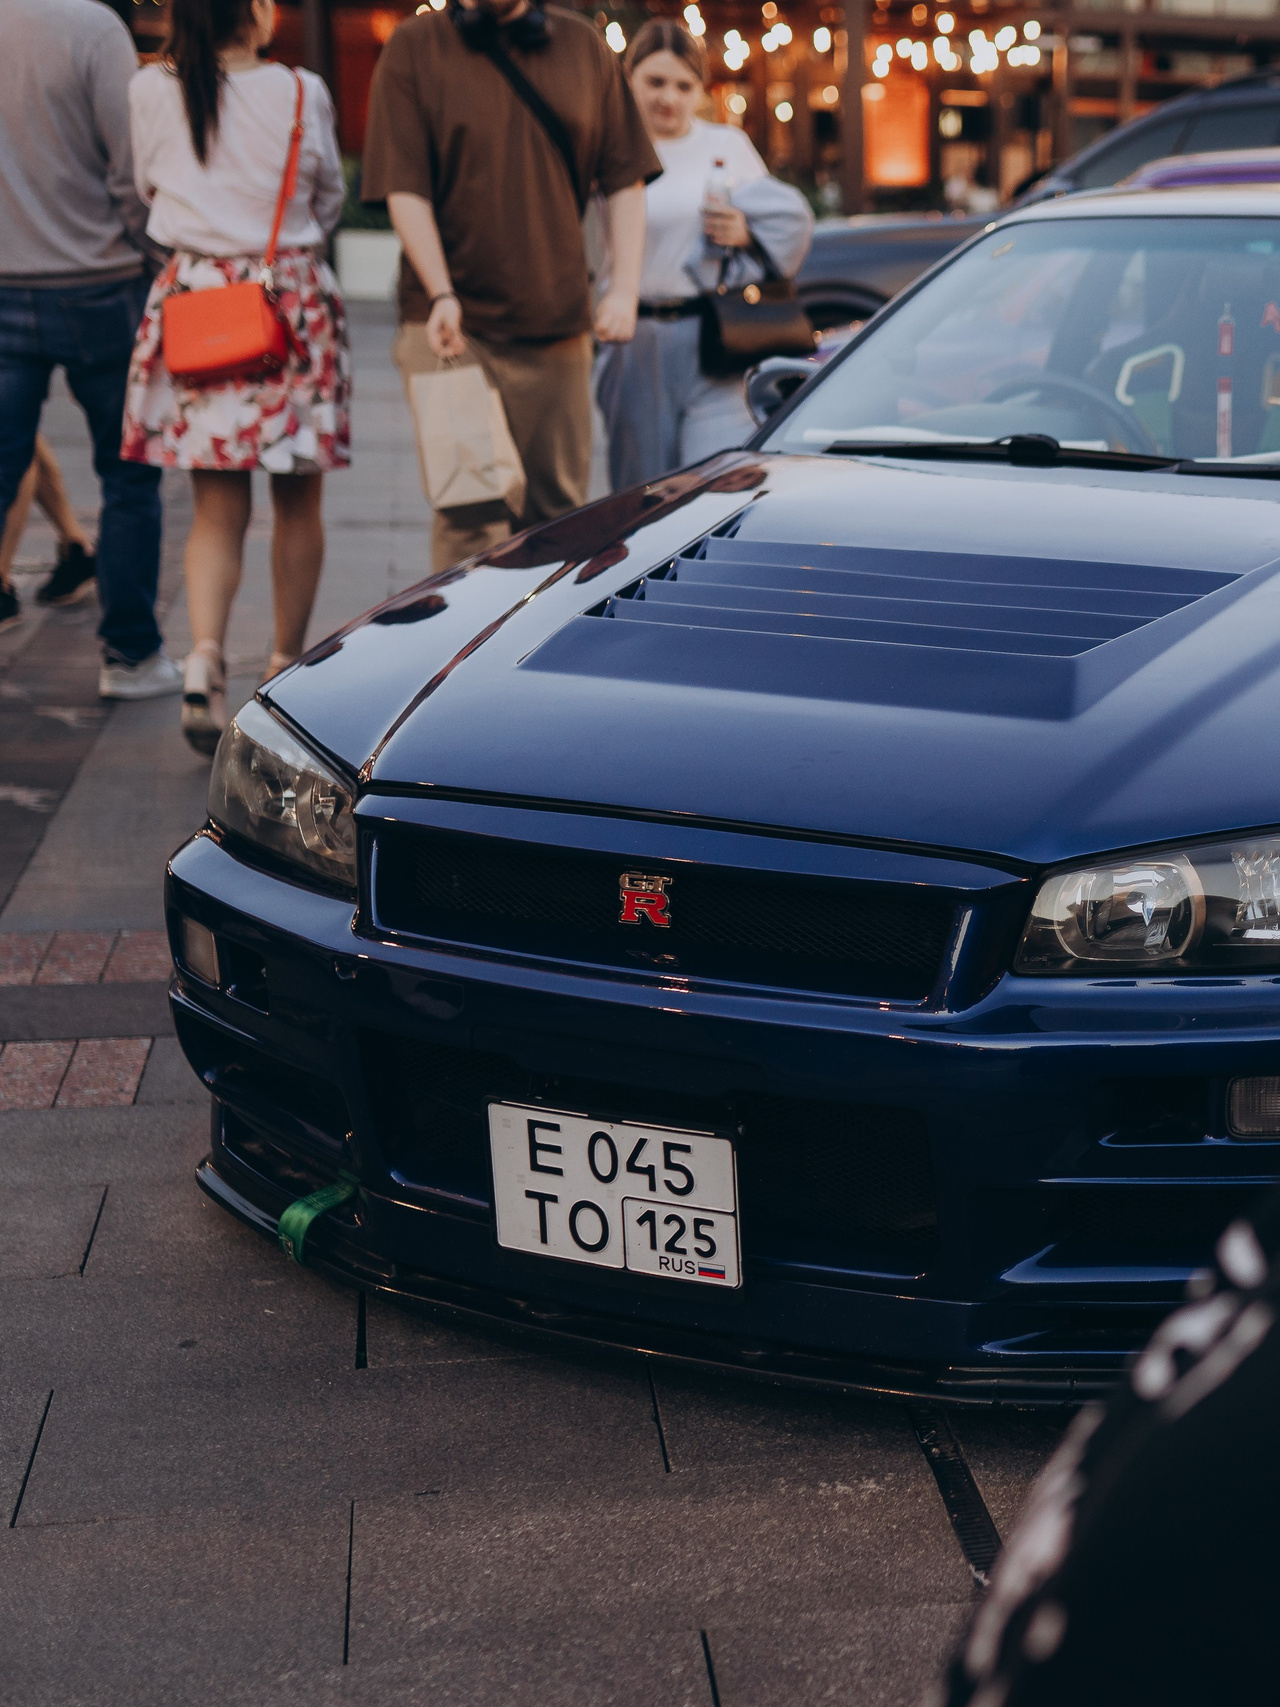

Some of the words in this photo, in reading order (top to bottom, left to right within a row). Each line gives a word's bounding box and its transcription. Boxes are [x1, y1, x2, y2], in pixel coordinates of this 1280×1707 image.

[527, 1118, 564, 1177] E
[588, 1130, 695, 1197] 045
[525, 1189, 610, 1253] TO
[636, 1209, 717, 1259] 125
[659, 1256, 696, 1275] RUS
